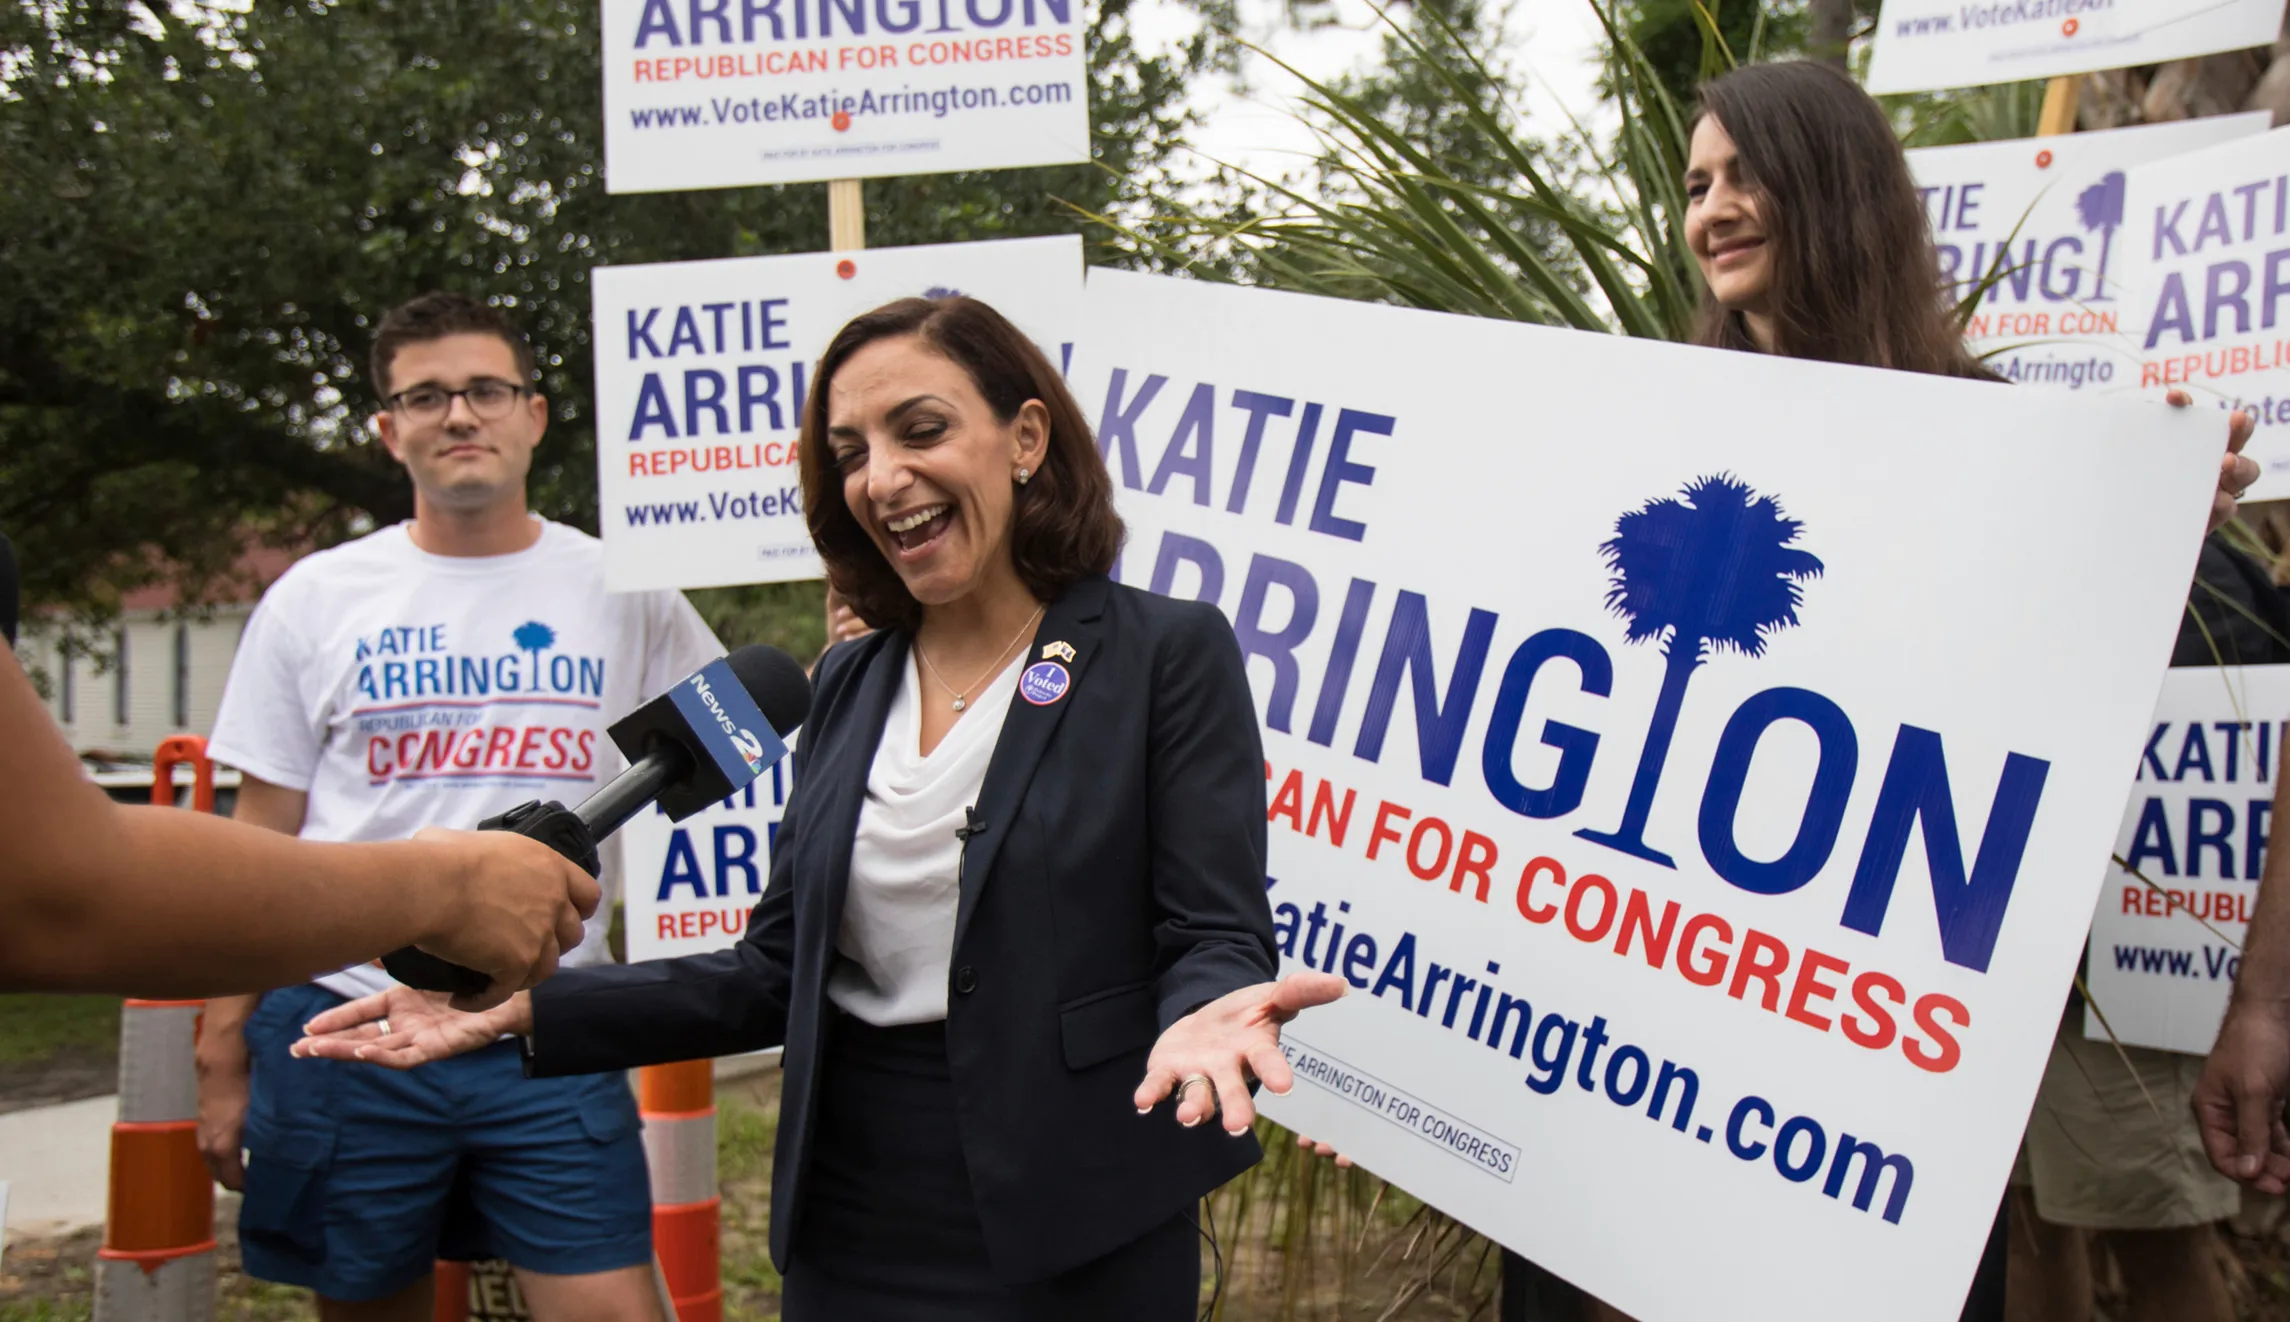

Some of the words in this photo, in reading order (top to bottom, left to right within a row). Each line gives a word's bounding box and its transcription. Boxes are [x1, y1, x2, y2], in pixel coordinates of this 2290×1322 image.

[634, 50, 827, 82] REPUBLICAN
[839, 45, 897, 70] FOR
[908, 34, 1072, 65] CONGRESS
[630, 80, 1072, 130] www.VoteKatieArrington.com
[2153, 175, 2289, 260] KATI
[627, 298, 791, 361] KATIE
[1998, 312, 2050, 337] FOR
[2059, 310, 2118, 336] CON
[2141, 339, 2290, 389] REPUBLI
[1098, 367, 1397, 543] KATIE
[355, 623, 447, 663] KATIE
[1027, 670, 1065, 694] Voted
[1046, 667, 1056, 679] I
[690, 673, 736, 735] News
[368, 726, 595, 777] CONGRESS
[730, 728, 763, 760] 2
[2136, 721, 2289, 784] KATI
[656, 820, 783, 902] AR
[657, 907, 752, 940] REPU
[1265, 760, 1357, 848] AN
[1366, 800, 1498, 904] FOR
[1516, 857, 1972, 1073] CONGRESS
[1266, 876, 1914, 1225] atieArrington.com
[1296, 1053, 1389, 1110] ARRINGTON
[1387, 1096, 1421, 1127] FOR
[1422, 1115, 1513, 1173] CONGRESS
